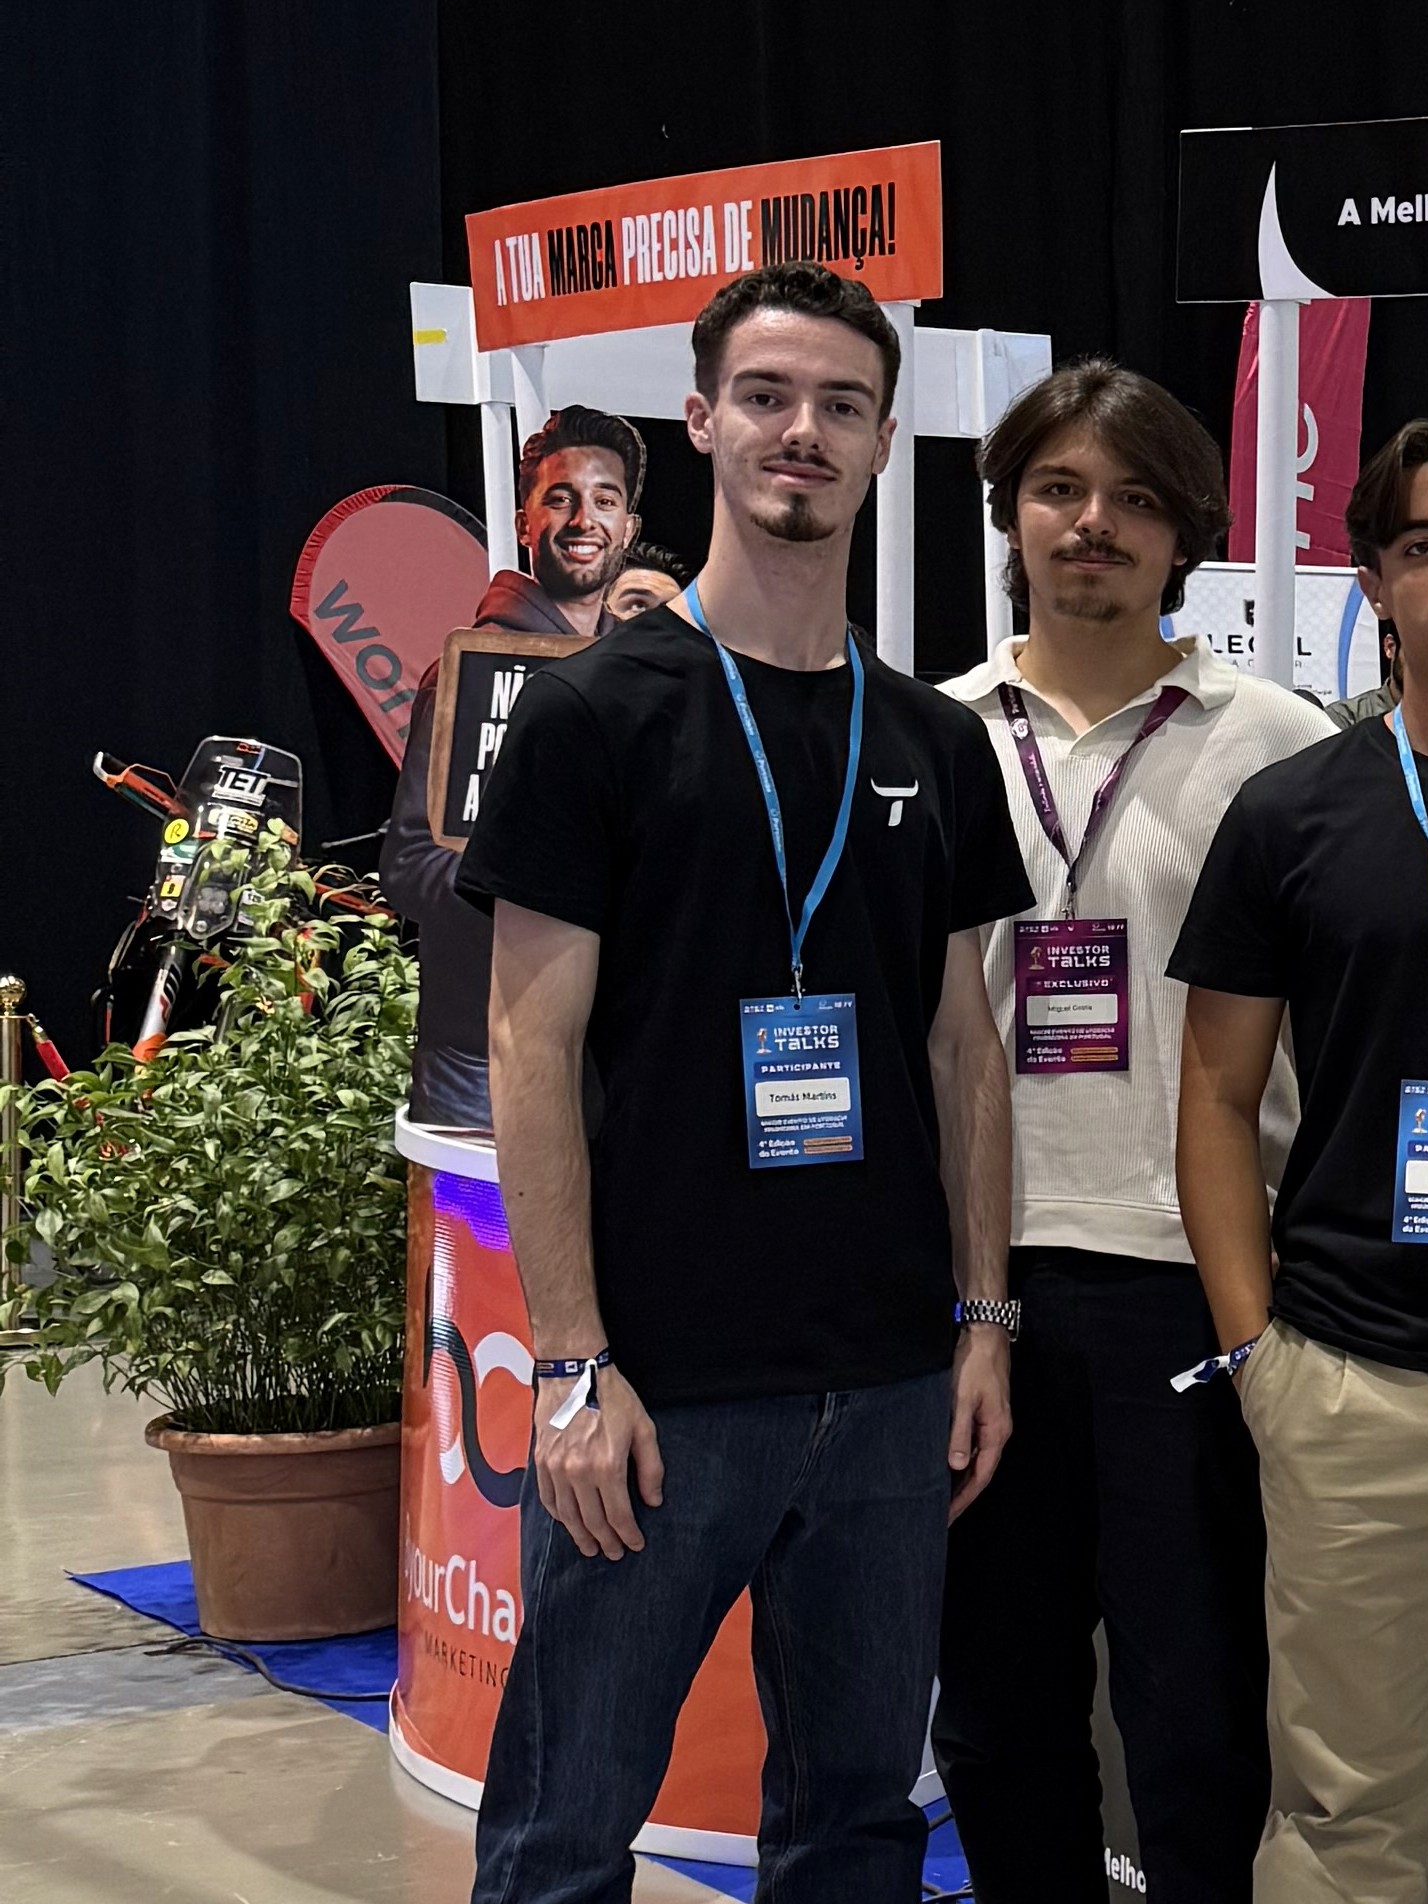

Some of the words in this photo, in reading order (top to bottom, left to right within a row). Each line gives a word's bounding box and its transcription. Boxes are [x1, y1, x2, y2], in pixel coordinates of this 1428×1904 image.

[1337, 197, 1361, 226] A
[494, 239, 507, 306] A
[506, 232, 545, 303] TUA
[547, 219, 617, 296] MARCA
[621, 205, 717, 286] PRECISA
[724, 199, 754, 271] DE
[760, 181, 896, 271] MUDANÇA!
[314, 578, 416, 741] wor
[1047, 945, 1110, 956] INVESTOR
[774, 1024, 838, 1037] INVESTOR
